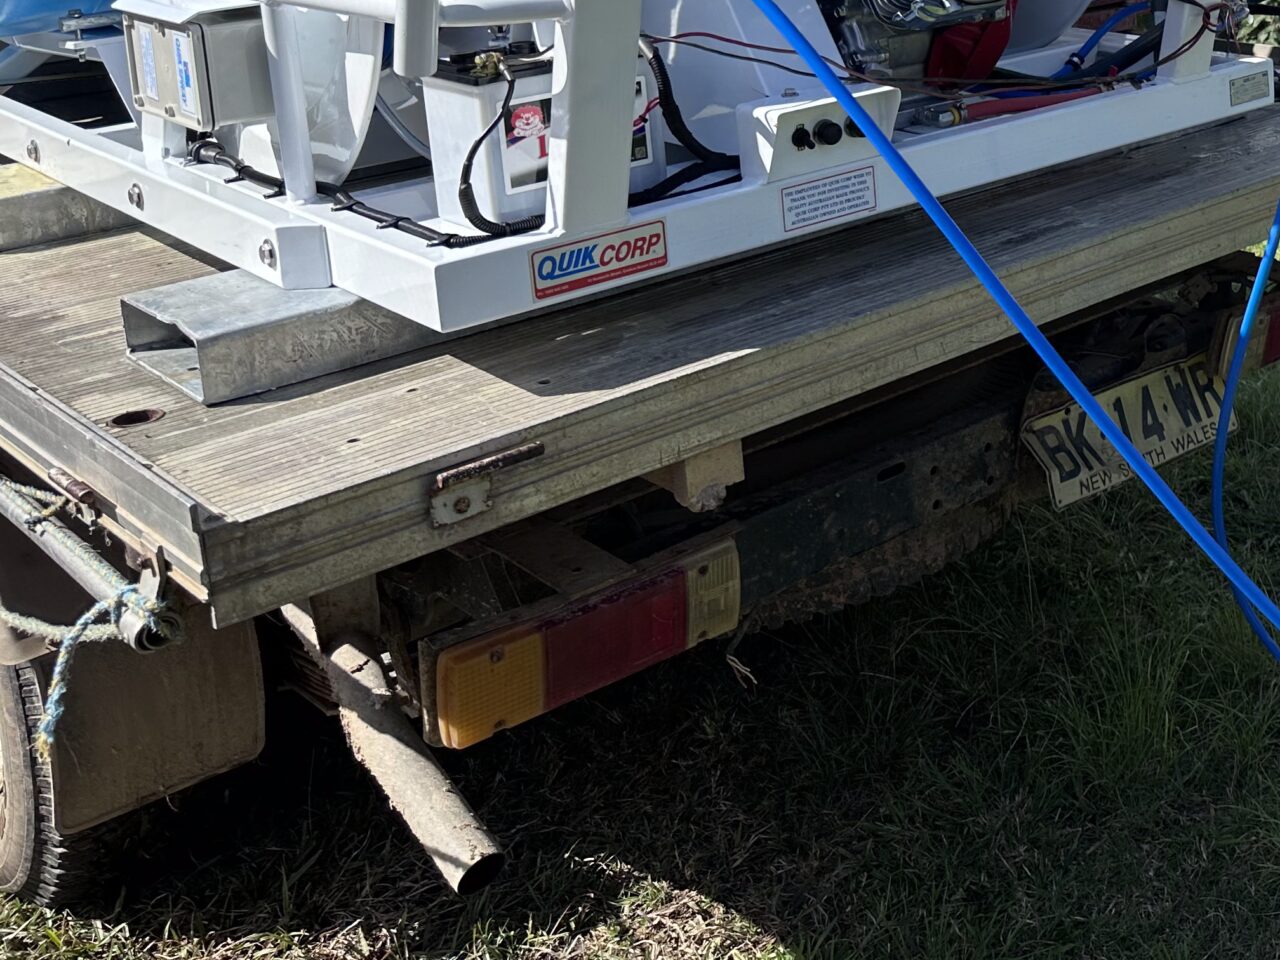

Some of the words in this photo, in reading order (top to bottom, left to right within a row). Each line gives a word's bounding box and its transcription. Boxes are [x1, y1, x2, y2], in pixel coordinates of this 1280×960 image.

[538, 243, 600, 280] QUIK
[599, 233, 661, 267] CORP
[1079, 470, 1113, 495] NEW
[1120, 445, 1166, 477] STH
[1171, 421, 1218, 454] WALES
